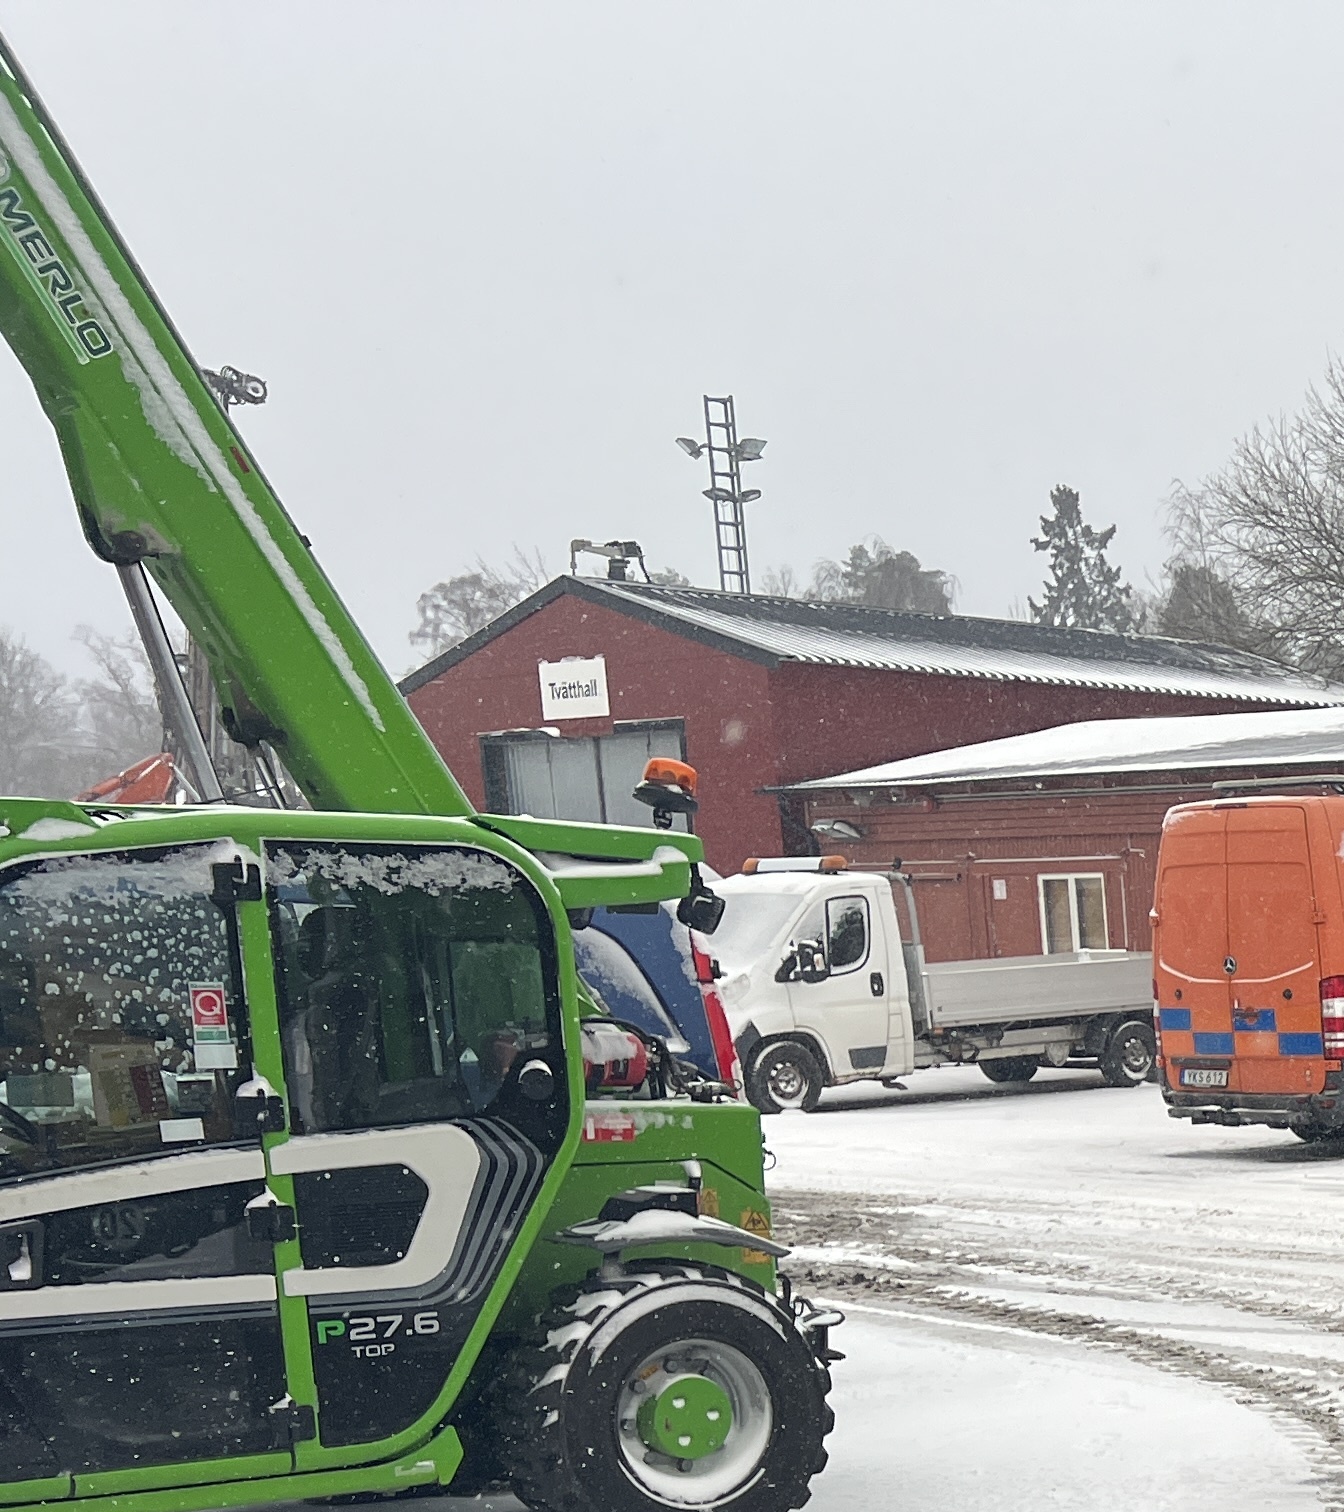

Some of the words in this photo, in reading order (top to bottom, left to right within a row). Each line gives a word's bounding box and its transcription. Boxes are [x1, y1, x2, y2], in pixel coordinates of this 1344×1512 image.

[0, 187, 113, 358] MERLO
[548, 679, 597, 700] Tvätthall
[1206, 1071, 1223, 1084] 612
[317, 1311, 440, 1344] P27.6
[351, 1343, 395, 1358] TOP
